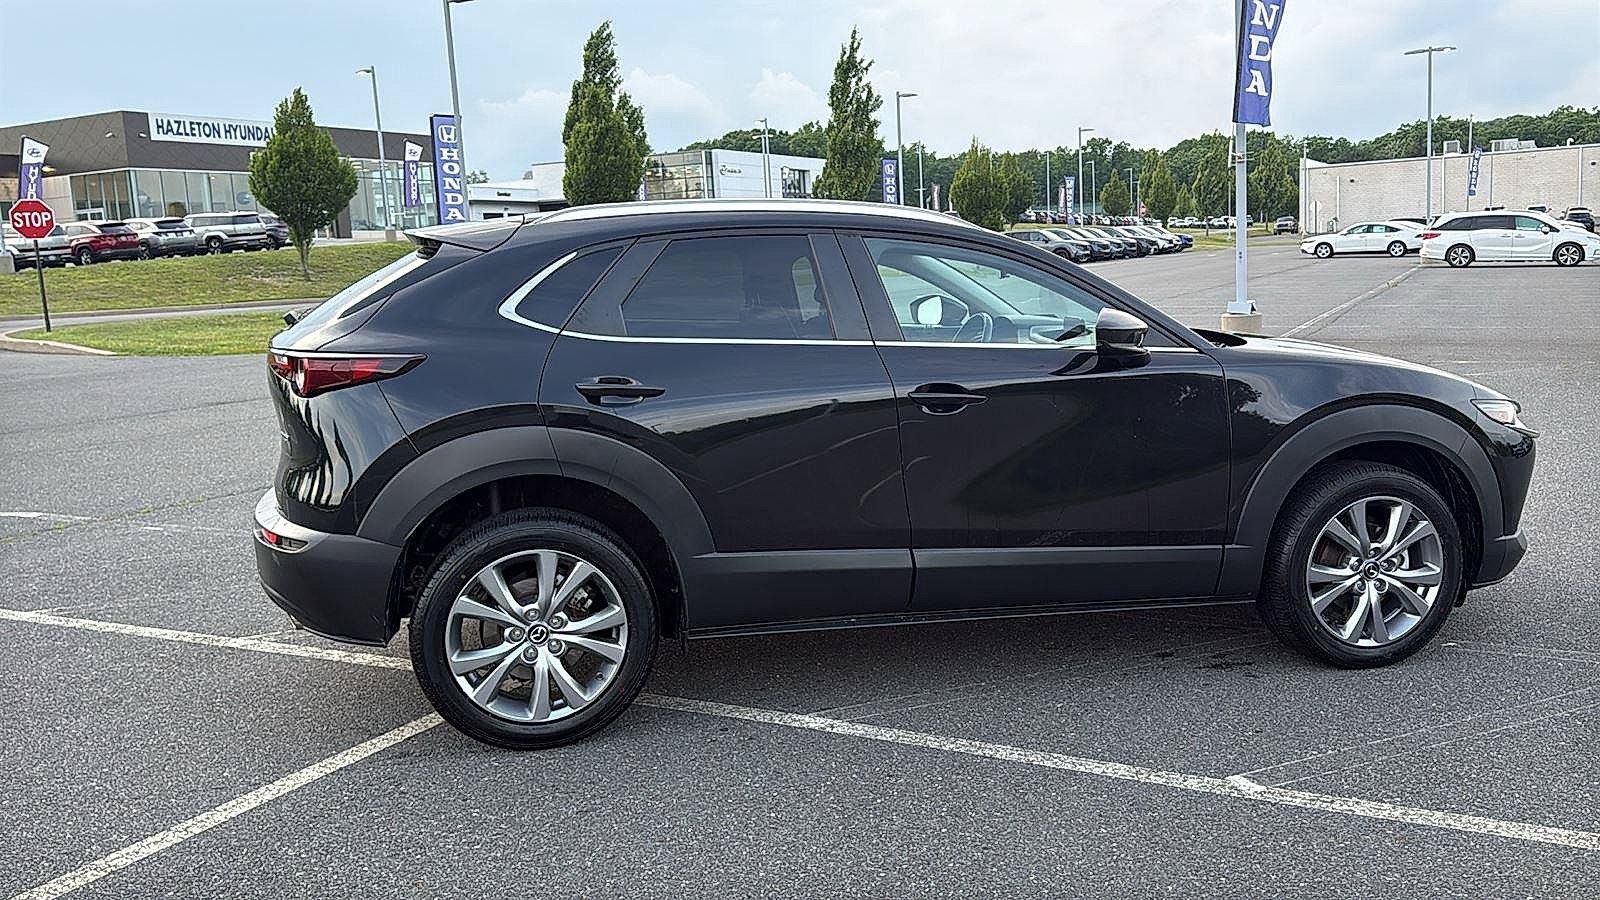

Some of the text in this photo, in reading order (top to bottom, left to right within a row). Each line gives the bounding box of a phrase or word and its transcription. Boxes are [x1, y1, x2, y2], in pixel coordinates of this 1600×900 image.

[155, 118, 221, 138] HAZLETON
[440, 147, 465, 221] HONDA
[13, 211, 52, 228] STOP
